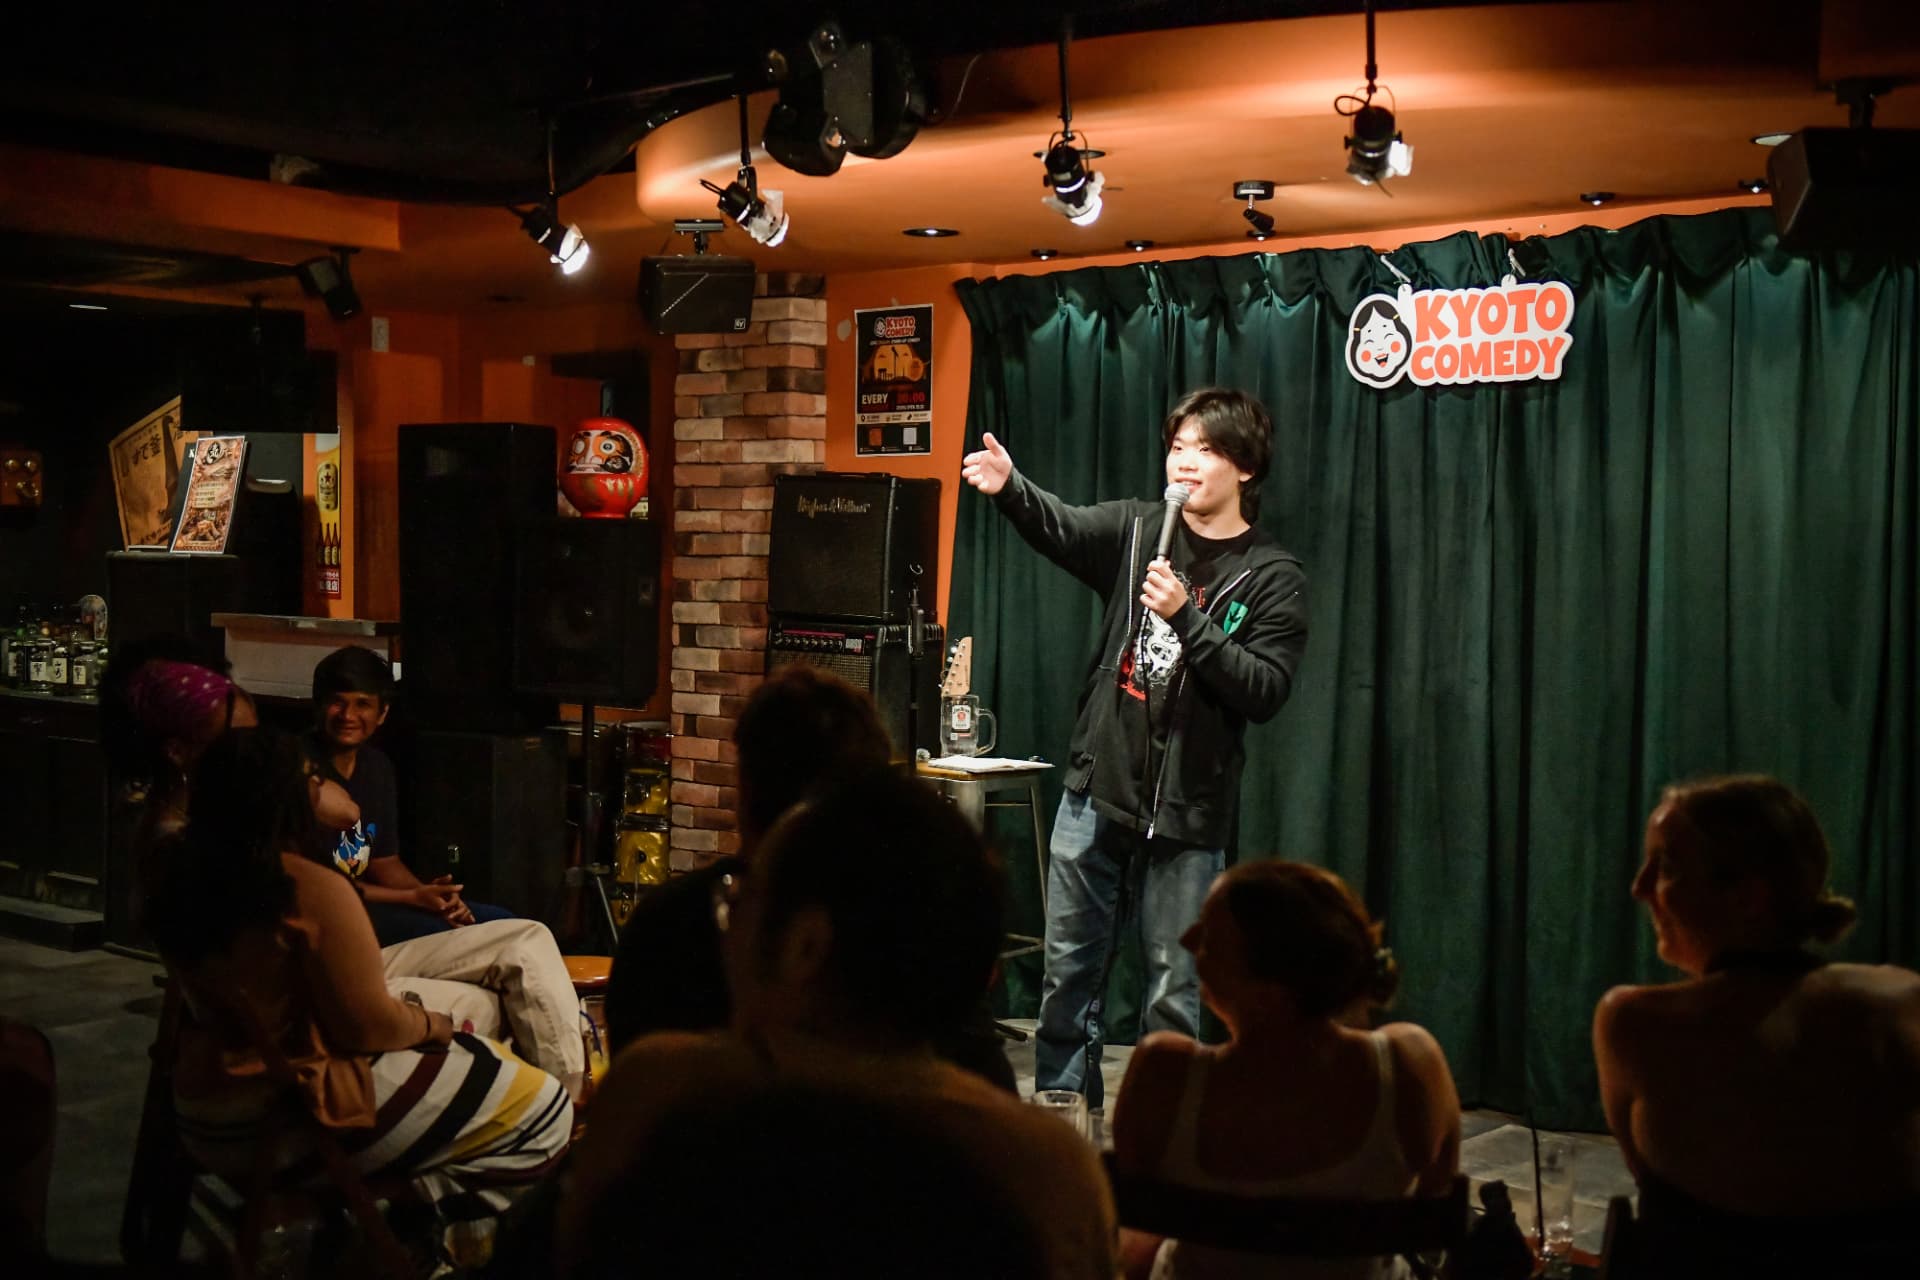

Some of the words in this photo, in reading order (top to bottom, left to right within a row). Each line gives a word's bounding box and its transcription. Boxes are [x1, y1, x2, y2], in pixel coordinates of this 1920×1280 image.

[1415, 287, 1567, 343] KYOTO
[886, 317, 914, 328] KYOTO
[885, 327, 914, 336] COMEDY
[1411, 336, 1565, 380] COMEDY
[861, 393, 889, 404] EVERY
